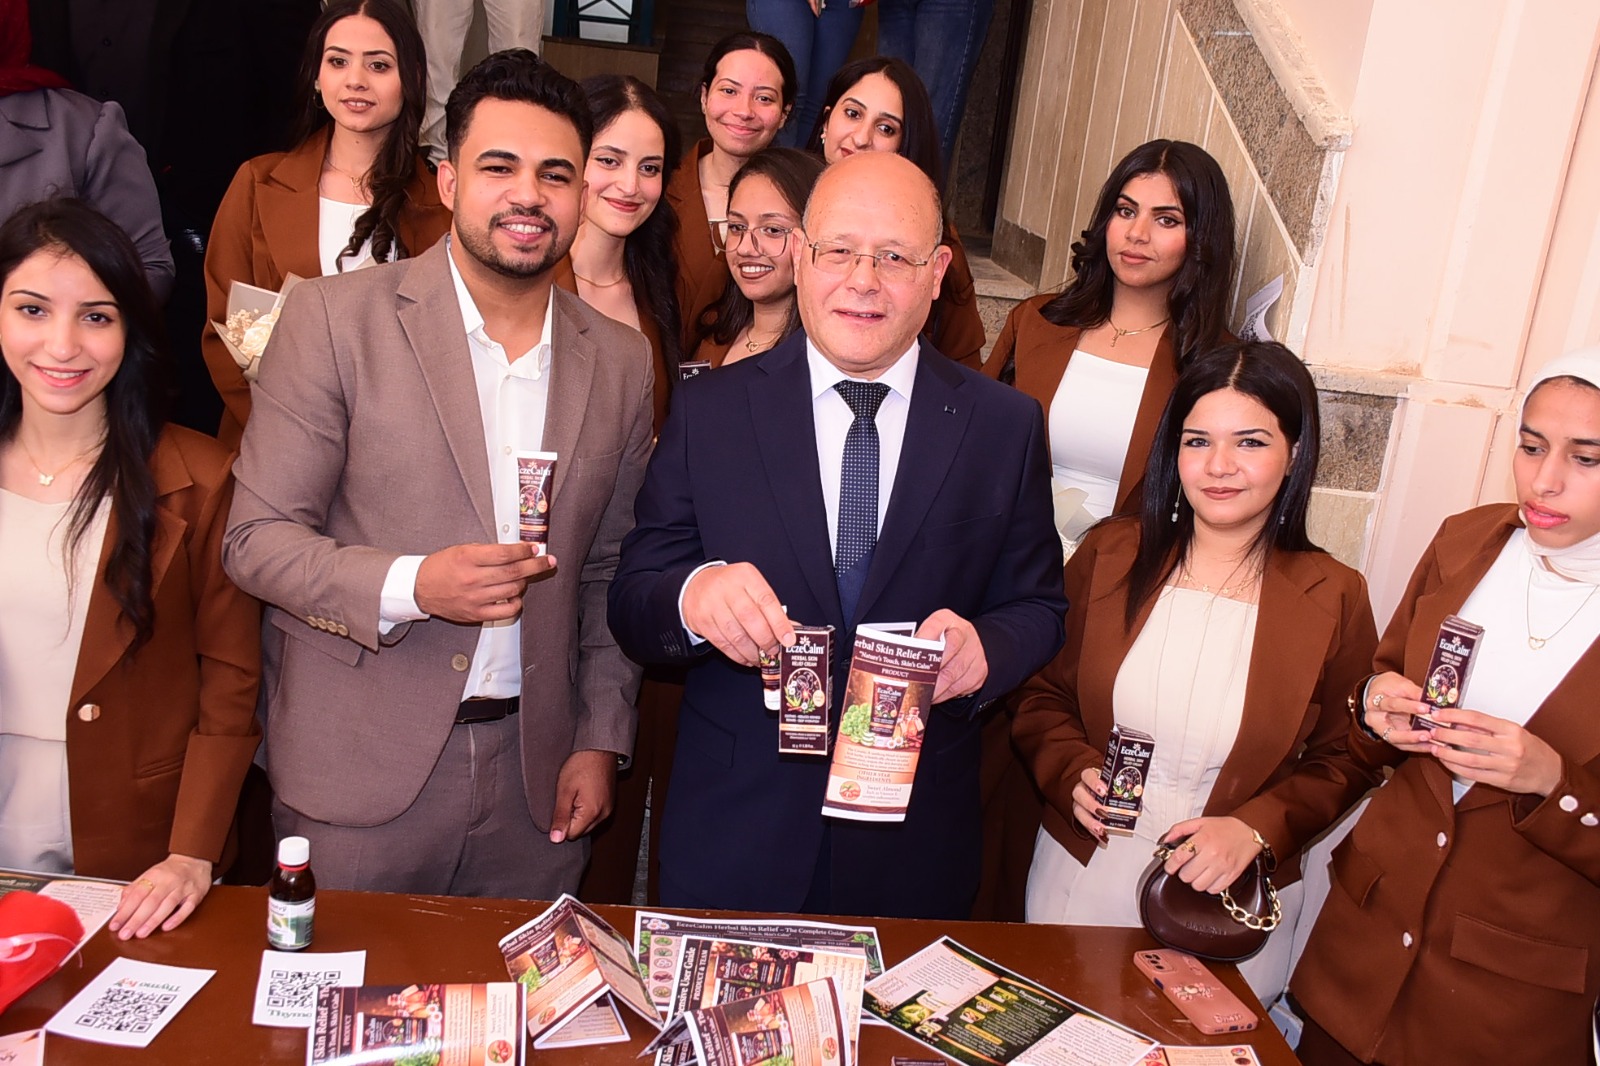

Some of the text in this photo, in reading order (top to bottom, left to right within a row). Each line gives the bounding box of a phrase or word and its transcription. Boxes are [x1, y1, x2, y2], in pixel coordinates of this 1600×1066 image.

[785, 643, 825, 654] EczeCalm
[875, 643, 894, 656] Skin
[895, 647, 922, 660] Relief
[927, 653, 943, 662] The
[881, 668, 910, 678] PRODUCT
[798, 928, 827, 936] Complete
[827, 929, 846, 937] Guide
[683, 947, 696, 969] Guide
[680, 969, 692, 986] User
[693, 973, 704, 1000] PRODUCT
[699, 949, 708, 966] TEAM
[319, 986, 330, 1000] Th
[315, 1006, 329, 1035] Relief
[342, 1014, 352, 1047] PRODUCT
[314, 1035, 326, 1059] Skin
[701, 1032, 716, 1059] Relief
